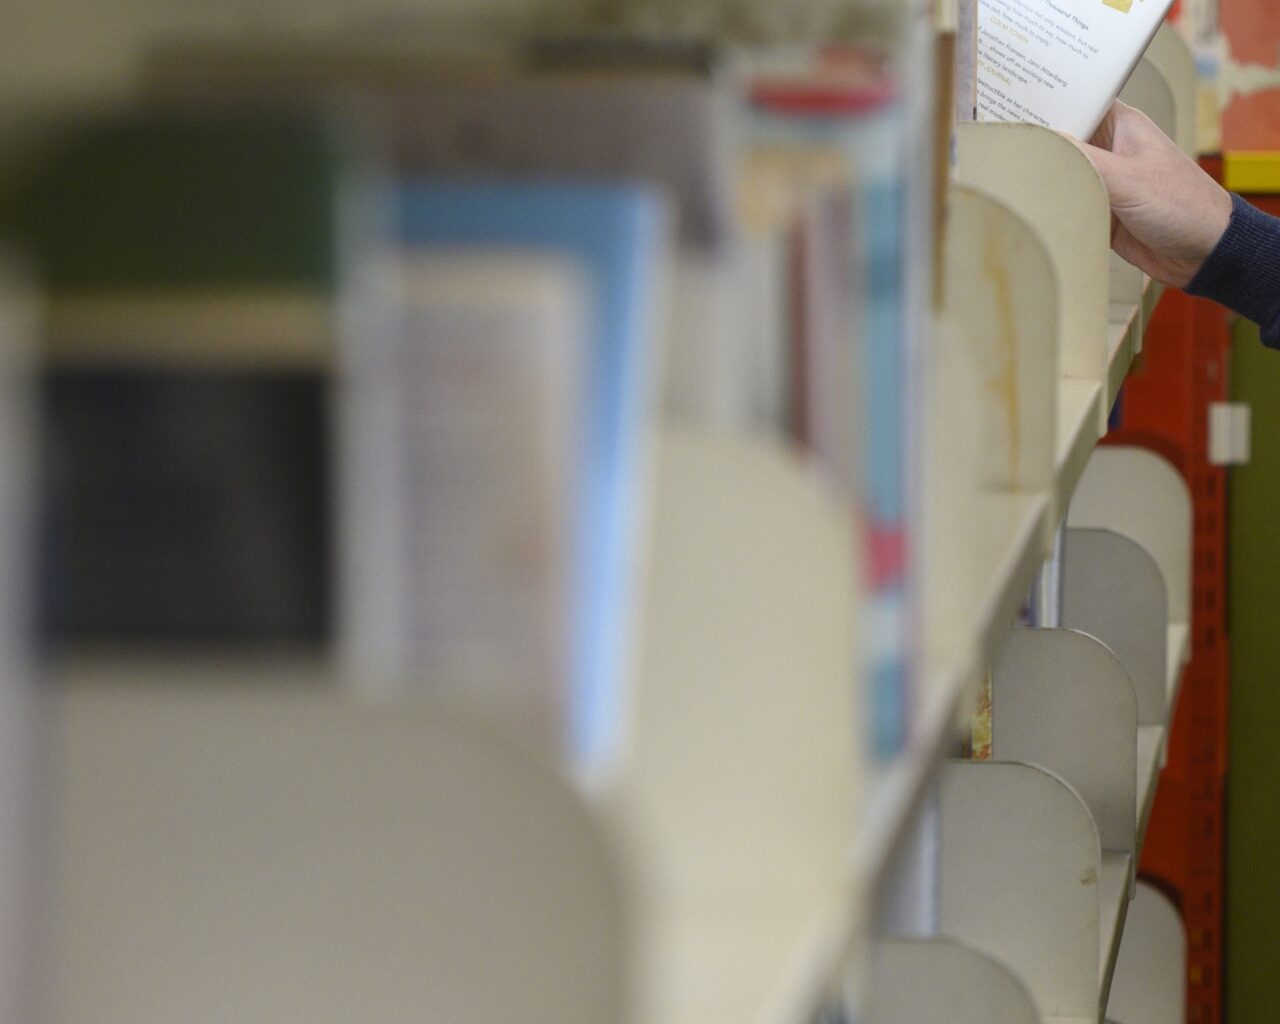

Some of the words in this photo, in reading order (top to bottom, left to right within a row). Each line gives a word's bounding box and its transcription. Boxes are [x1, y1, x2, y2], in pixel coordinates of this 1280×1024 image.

[1001, 12, 1013, 22] how
[1013, 20, 1028, 32] much
[1070, 15, 1090, 31] Things
[1076, 37, 1087, 46] but
[1087, 43, 1099, 53] real
[981, 28, 1005, 46] Jonathan
[1039, 65, 1068, 87] Attenberg
[989, 45, 1006, 58] shows
[1042, 79, 1054, 89] new
[984, 64, 1012, 84] JOURNAL
[979, 91, 997, 105] brings
[996, 101, 1007, 110] the
[1022, 106, 1050, 126] characters
